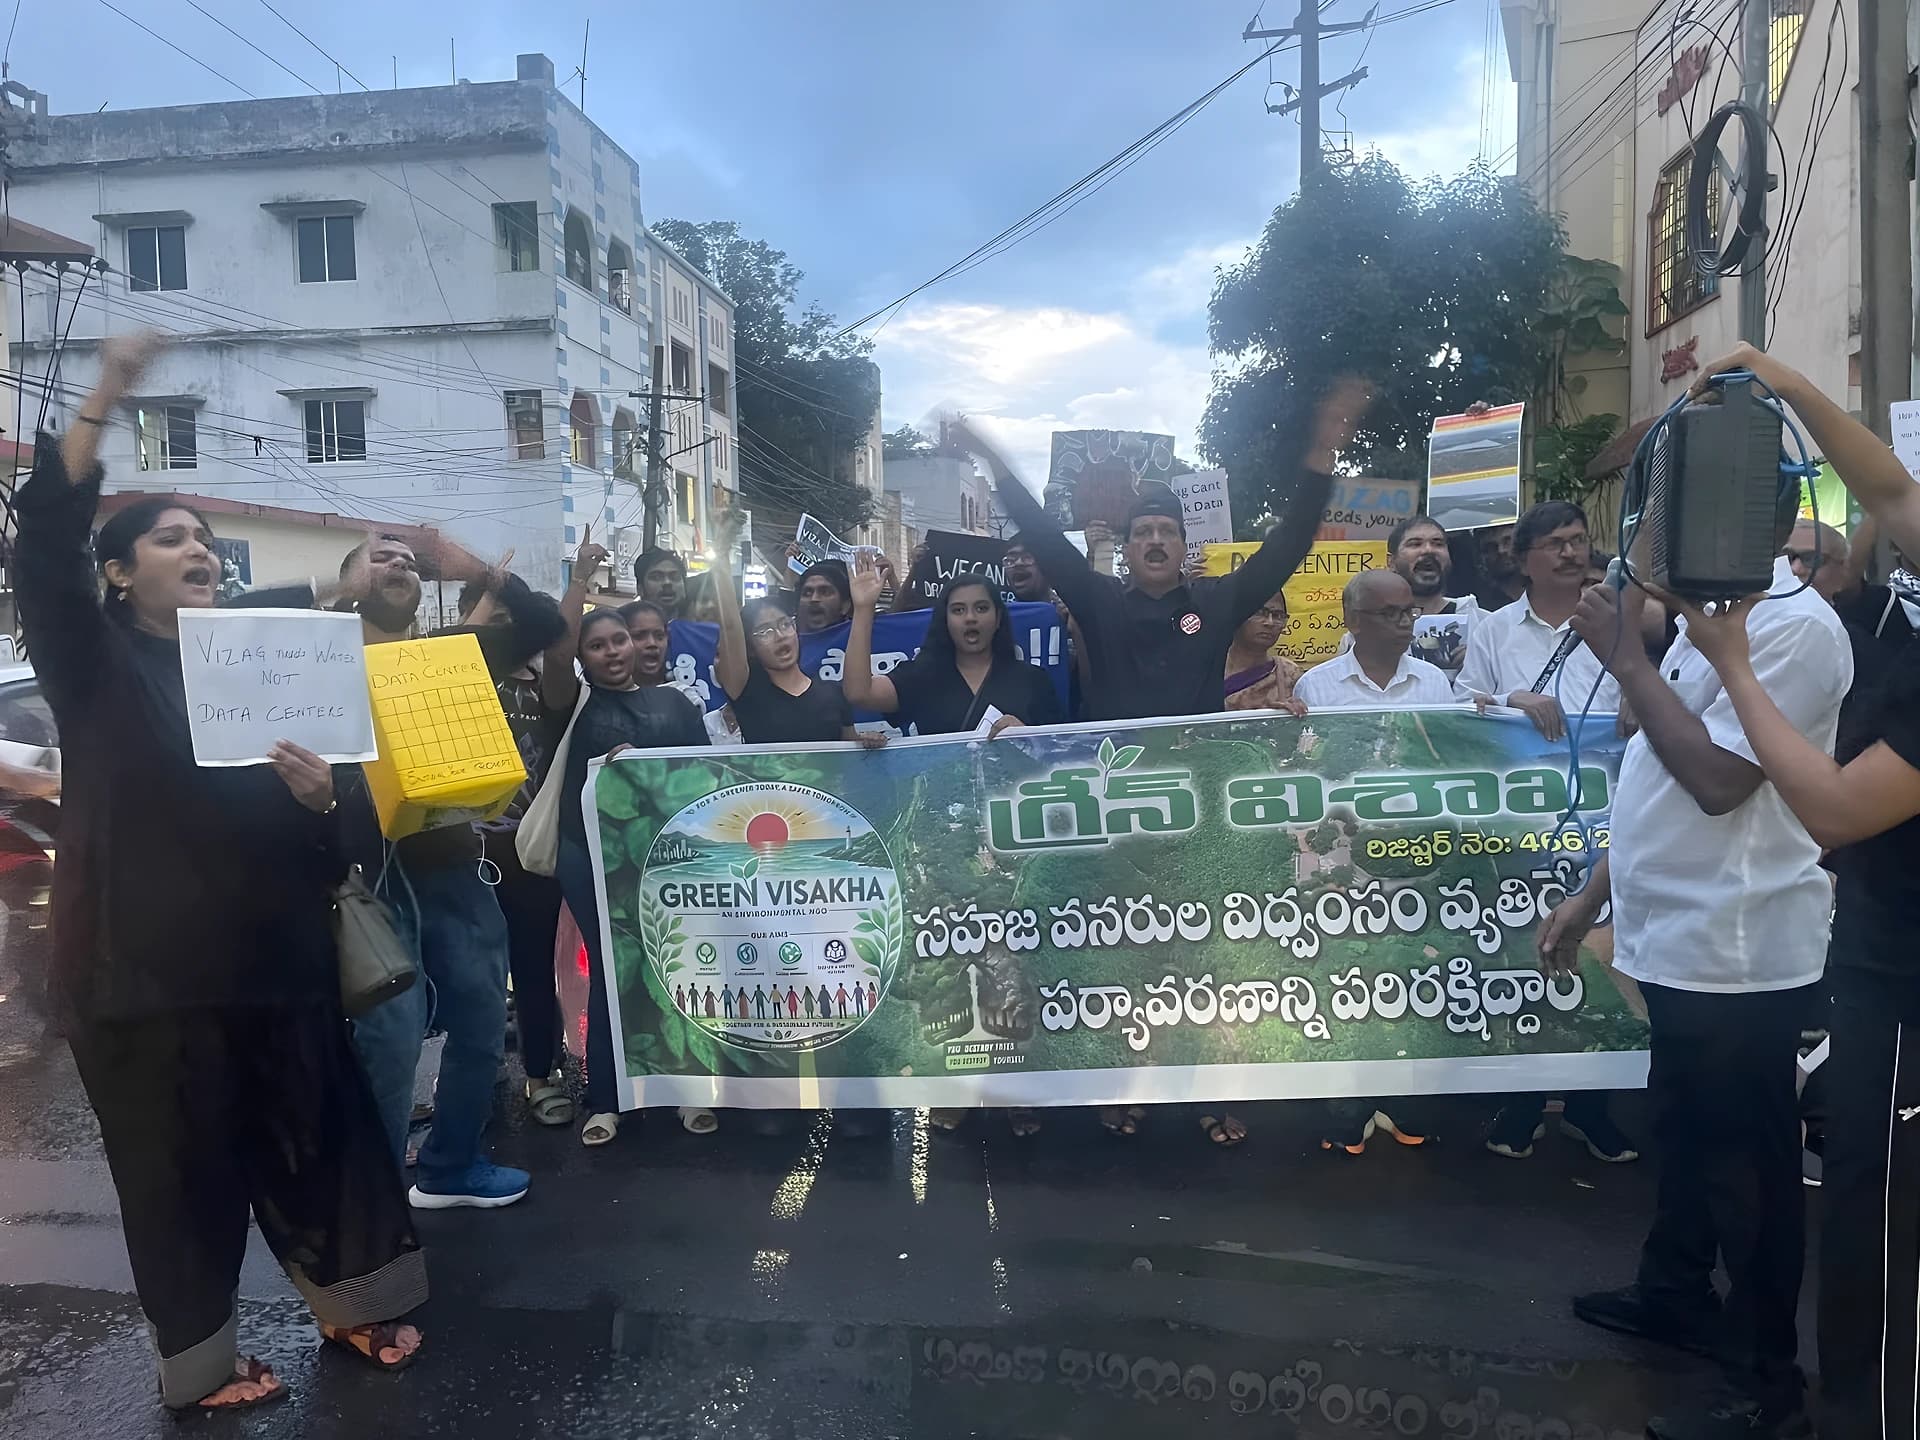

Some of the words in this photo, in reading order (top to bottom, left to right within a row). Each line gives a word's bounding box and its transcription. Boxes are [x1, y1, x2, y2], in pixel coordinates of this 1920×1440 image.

[1191, 481, 1221, 494] Cant
[1323, 510, 1362, 525] eeds
[1294, 553, 1373, 574] ENTER
[196, 631, 266, 666] VIZAG
[396, 642, 431, 666] AI
[261, 669, 301, 686] NOT
[372, 672, 419, 689] DATA
[197, 703, 251, 723] DATA
[266, 705, 344, 723] CENTERS
[659, 878, 758, 908] GREEN
[765, 876, 885, 906] VISAKHA
[912, 903, 1041, 958] సహజ
[1048, 894, 1212, 948] వనరుల
[1222, 880, 1428, 958] విధ్వంసం
